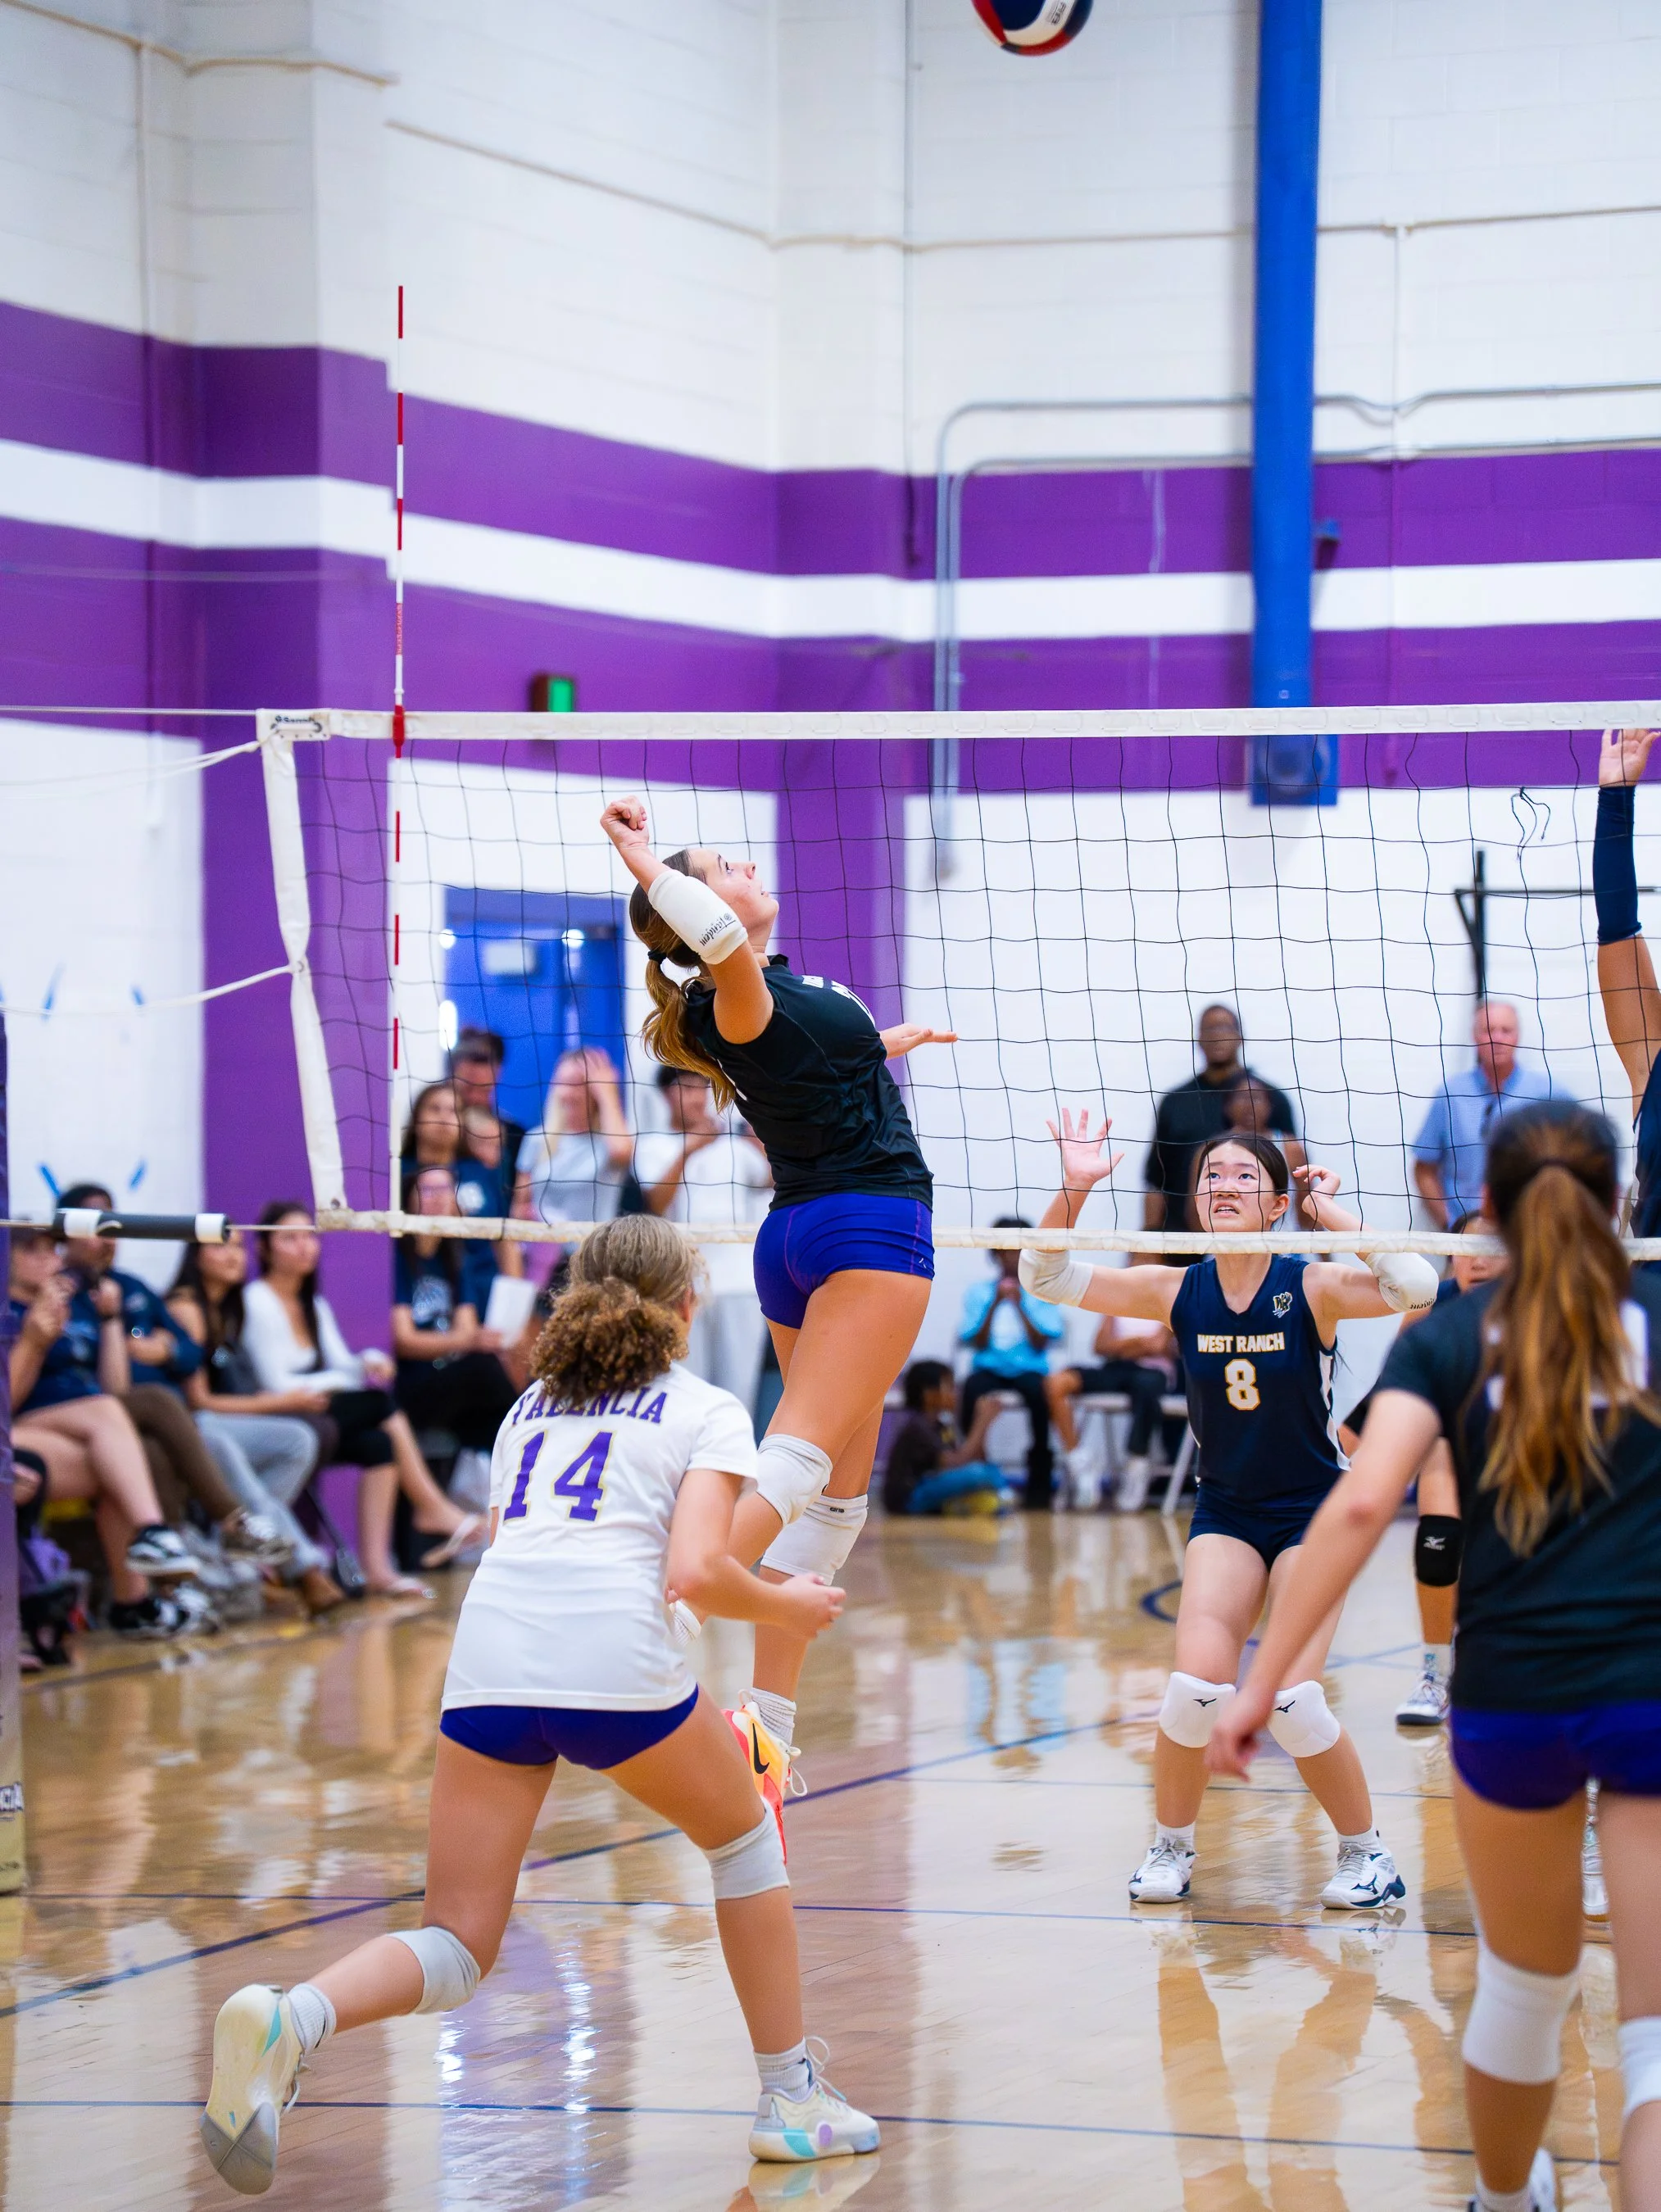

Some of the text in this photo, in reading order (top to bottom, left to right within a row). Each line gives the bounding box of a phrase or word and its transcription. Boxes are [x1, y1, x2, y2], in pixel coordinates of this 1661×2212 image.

[1197, 1334, 1233, 1353] WEST
[1236, 1332, 1285, 1353] RANCH
[1224, 1358, 1261, 1411] 8
[502, 1429, 615, 1525] 14
